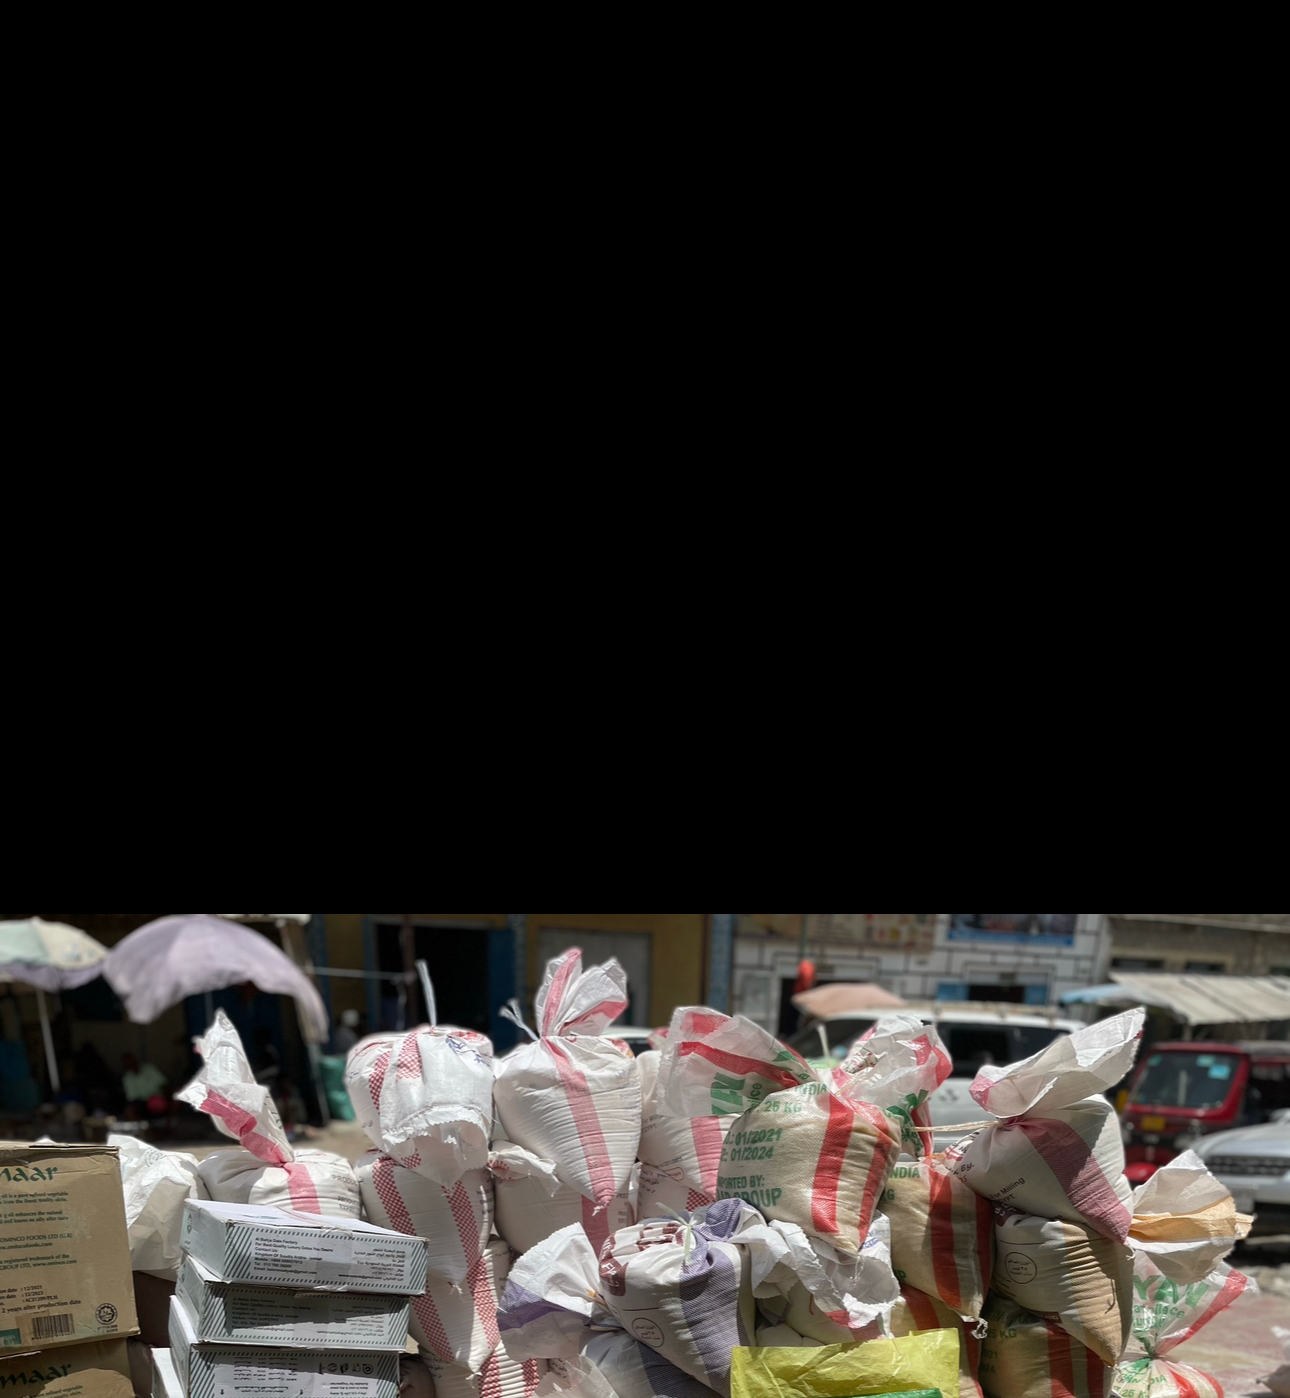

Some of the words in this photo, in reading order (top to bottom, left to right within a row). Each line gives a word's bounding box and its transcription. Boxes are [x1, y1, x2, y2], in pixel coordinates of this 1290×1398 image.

[764, 1100, 780, 1112] 25
[784, 1102, 801, 1113] KG
[735, 1128, 783, 1146] 01/2021
[731, 1146, 775, 1162] 01/2024
[750, 1175, 766, 1188] BY:
[1000, 1177, 1026, 1195] Milling
[37, 1301, 69, 1309] production
[1000, 1328, 1017, 1339] KG
[1121, 1389, 1135, 1398] 25
